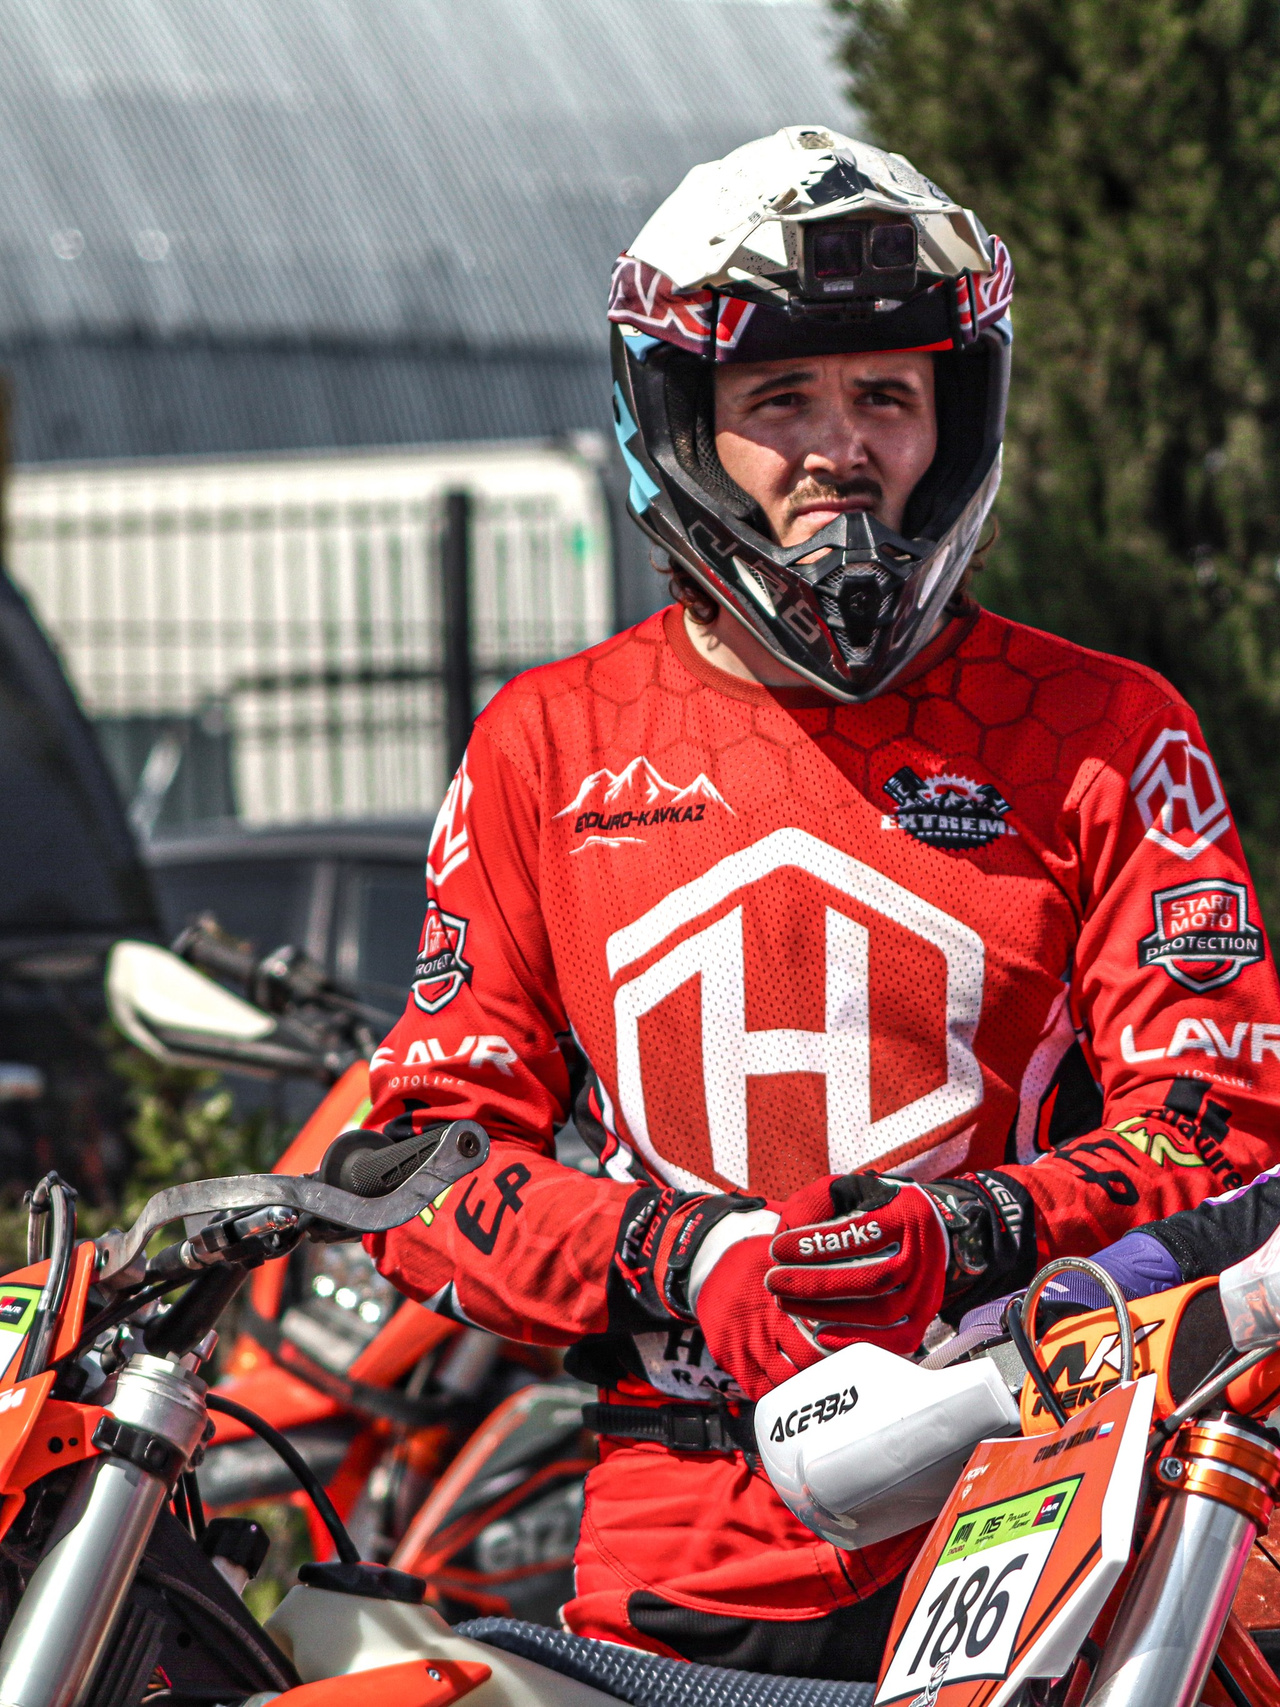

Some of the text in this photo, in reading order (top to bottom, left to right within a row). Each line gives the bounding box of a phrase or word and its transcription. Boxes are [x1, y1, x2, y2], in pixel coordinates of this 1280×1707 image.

[1171, 894, 1233, 918] START
[1170, 911, 1233, 936] MOTO
[1145, 935, 1259, 962] PROTECTION
[798, 1220, 882, 1256] starks
[769, 1384, 860, 1443] ACERBIS
[906, 1552, 1030, 1677] 186
